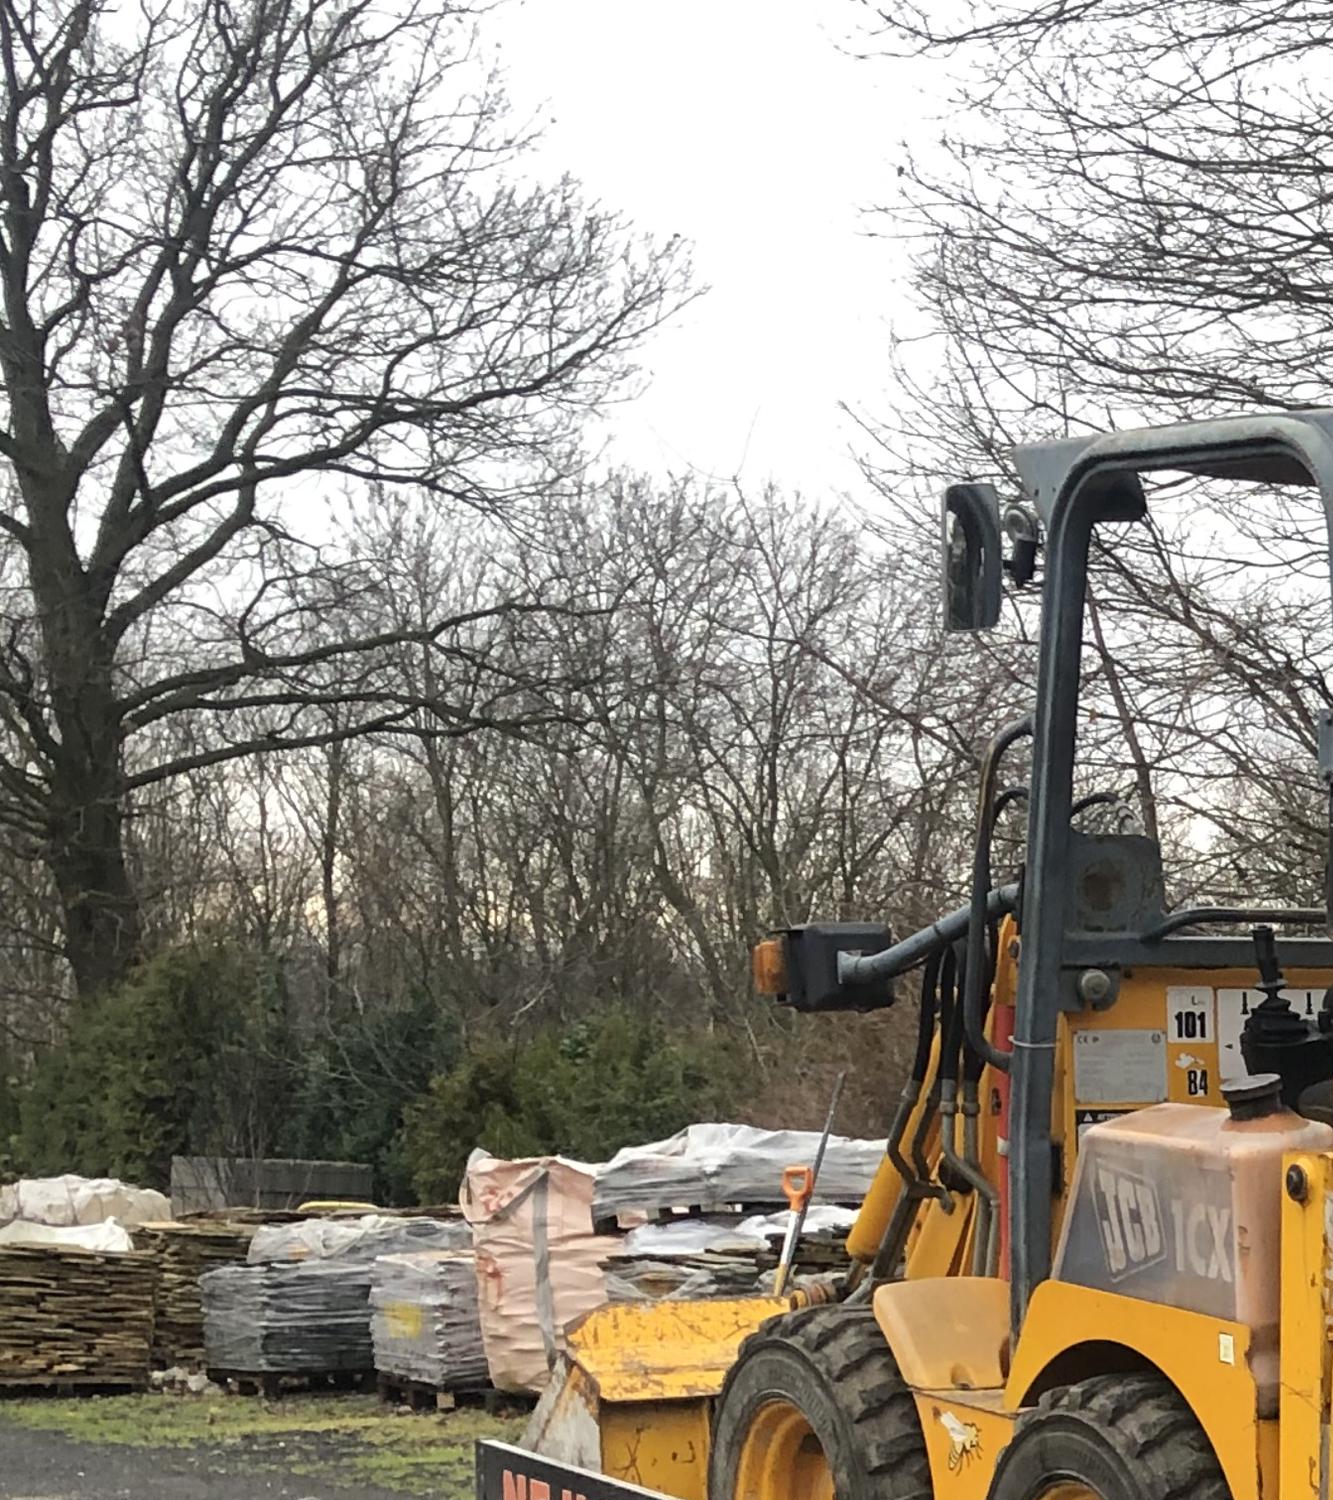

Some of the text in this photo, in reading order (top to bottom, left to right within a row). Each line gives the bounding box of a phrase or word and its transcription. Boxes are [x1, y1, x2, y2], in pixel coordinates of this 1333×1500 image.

[1174, 1010, 1207, 1039] 101
[1187, 1069, 1208, 1096] 84
[1098, 1167, 1233, 1283] JCB 1CX
